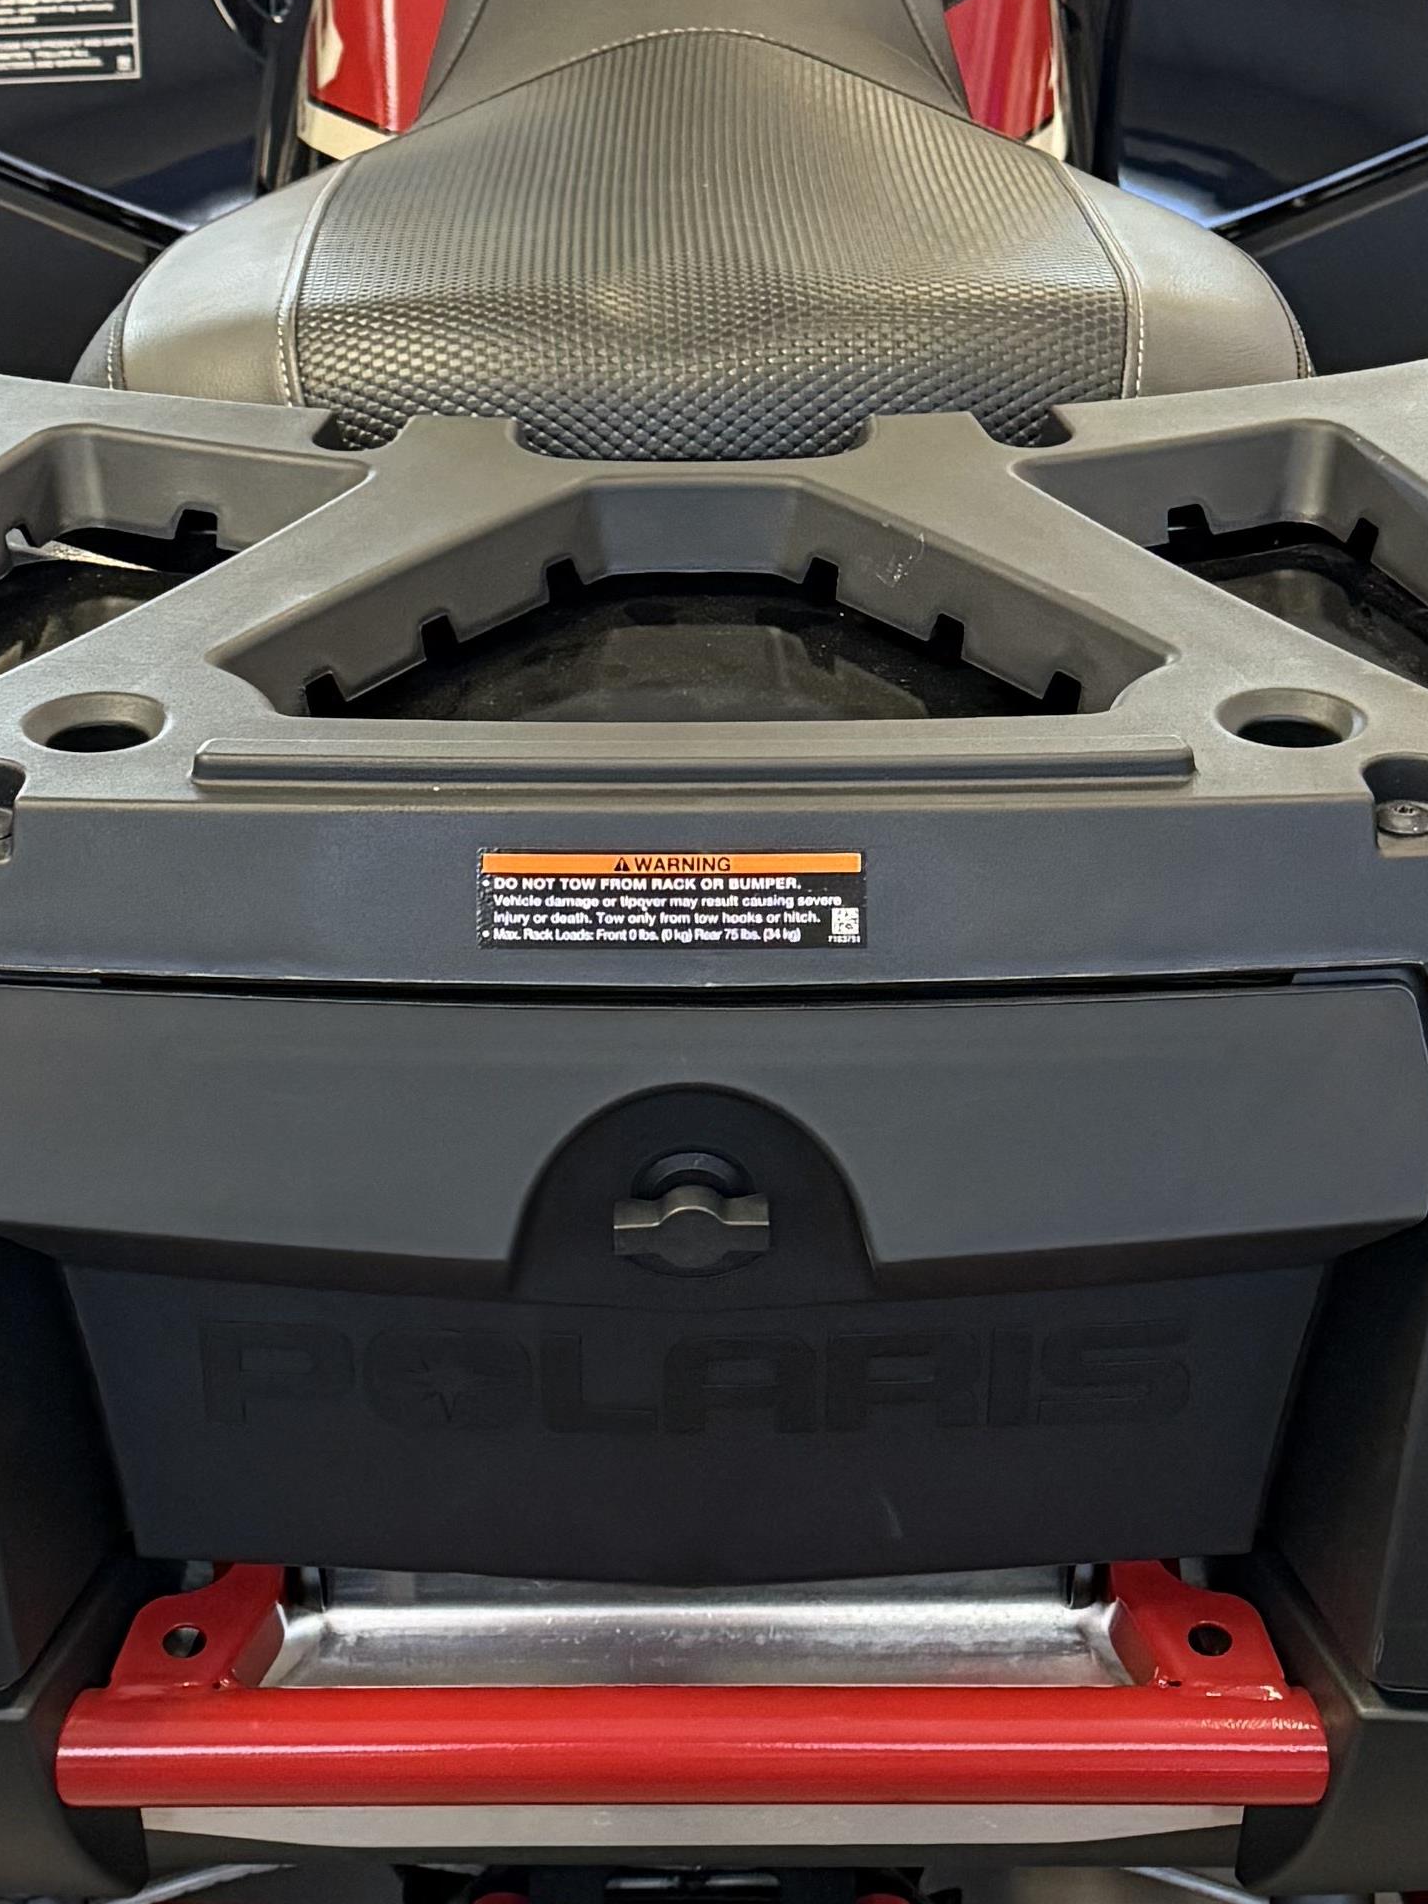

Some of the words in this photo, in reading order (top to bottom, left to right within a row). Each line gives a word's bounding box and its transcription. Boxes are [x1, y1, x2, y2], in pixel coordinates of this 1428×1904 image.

[634, 857, 731, 872] WARNING
[493, 877, 518, 891] DO
[522, 877, 555, 891] NOT
[560, 877, 596, 891] TOW
[600, 877, 647, 891] FROM
[652, 877, 696, 891] RACK
[700, 877, 724, 891] OR
[728, 877, 802, 891] BUMPER.
[493, 895, 542, 907] Vehicle
[545, 895, 599, 910] damage
[603, 897, 617, 907] or
[620, 895, 666, 910] tipover
[670, 897, 698, 910] may
[701, 895, 739, 907] result
[742, 895, 794, 910] causing
[797, 896, 842, 907] severe
[493, 911, 530, 926] injury
[533, 914, 547, 924] or
[550, 912, 593, 924] death.
[596, 912, 625, 924] Tow
[628, 911, 656, 926] only
[660, 912, 690, 924] from
[694, 912, 719, 924] tow
[722, 911, 763, 924] hooks
[766, 914, 781, 924] or
[783, 911, 821, 924] hitch.
[493, 928, 522, 941] Max.
[523, 928, 554, 941] Rack
[555, 928, 594, 941] Loads:
[596, 928, 627, 941] Front
[628, 928, 638, 941] 0
[639, 928, 660, 941] lbs.
[661, 928, 673, 943] (0
[674, 928, 693, 943] kg)
[695, 928, 722, 941] Rear
[724, 928, 739, 941] 75
[741, 928, 761, 941] lbs.
[783, 928, 801, 943] kg)
[199, 1318, 1191, 1435] POLARIS
